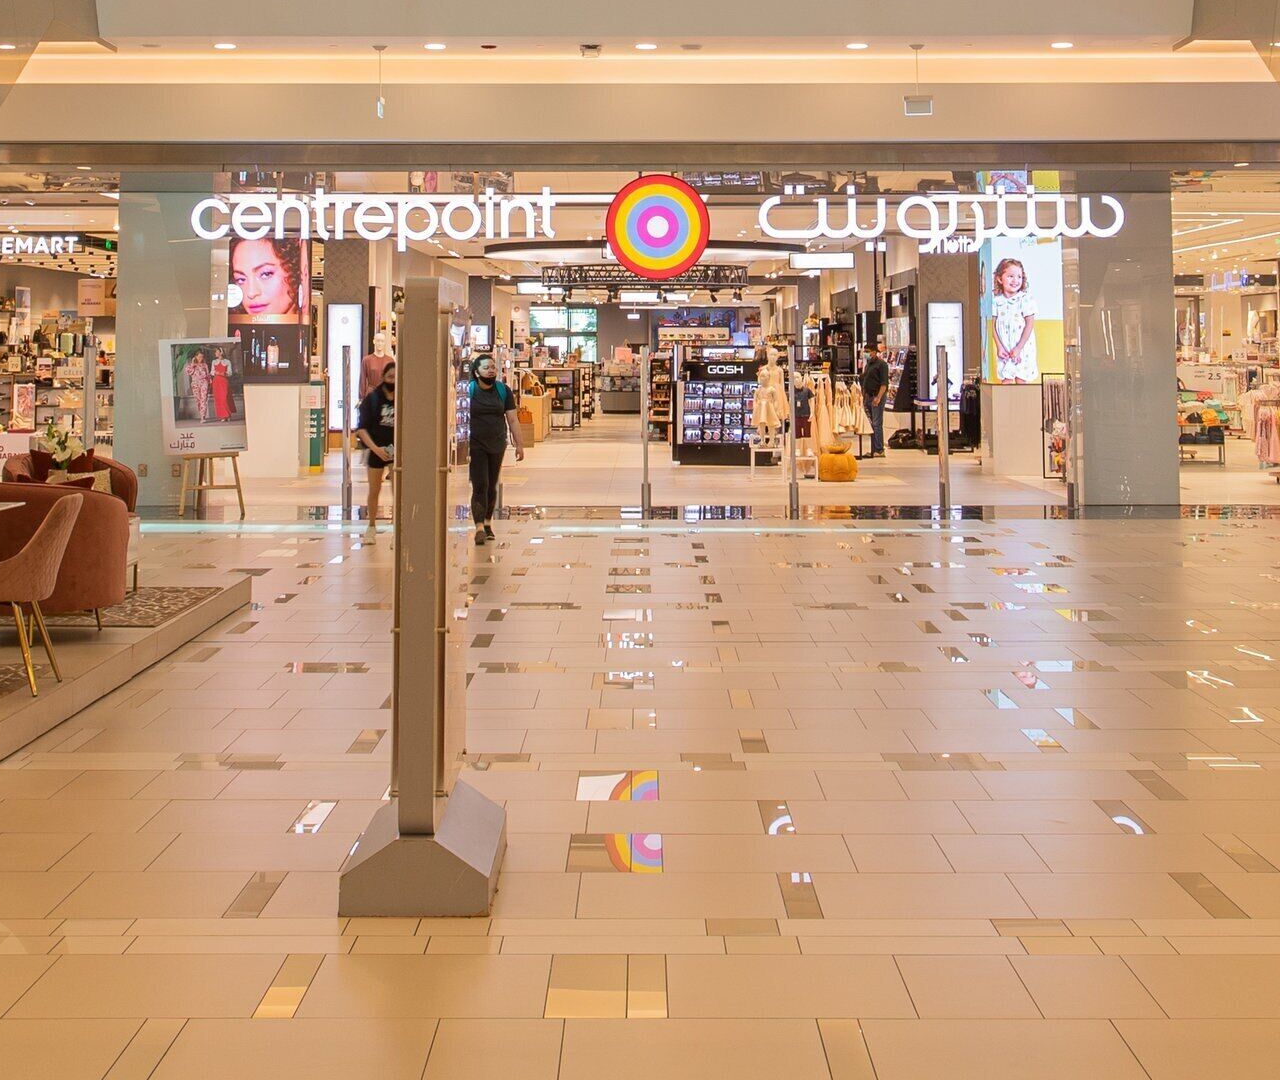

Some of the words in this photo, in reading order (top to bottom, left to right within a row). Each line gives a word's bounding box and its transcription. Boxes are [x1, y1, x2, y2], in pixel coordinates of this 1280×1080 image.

[191, 185, 557, 252] centrepoint
[757, 184, 1126, 254] سنتربوينت
[707, 365, 744, 374] GOSH
[1208, 373, 1222, 381] 2.5
